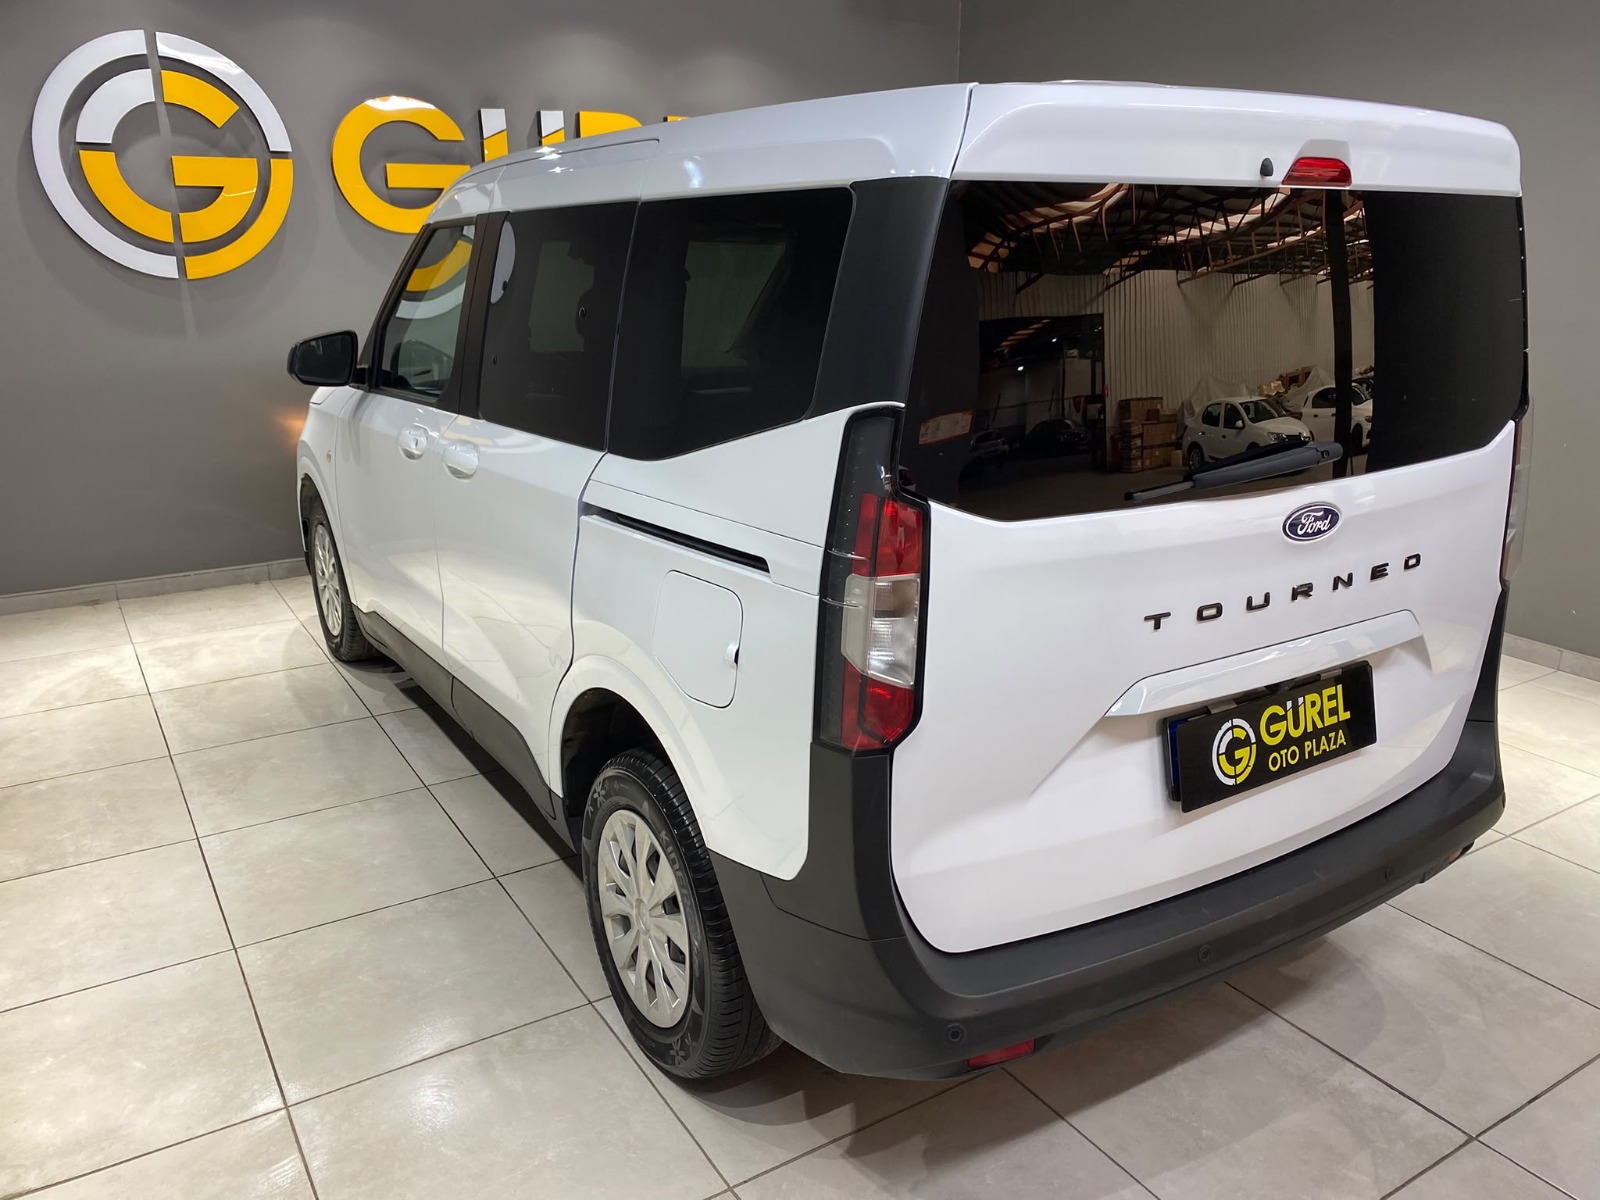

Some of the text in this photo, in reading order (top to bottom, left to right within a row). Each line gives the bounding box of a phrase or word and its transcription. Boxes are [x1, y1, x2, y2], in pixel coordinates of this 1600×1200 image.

[1297, 510, 1332, 535] Ford
[1144, 553, 1421, 630] TOURNEO
[1259, 684, 1351, 746] GÜREL
[1268, 729, 1347, 772] OTO PLAZA
